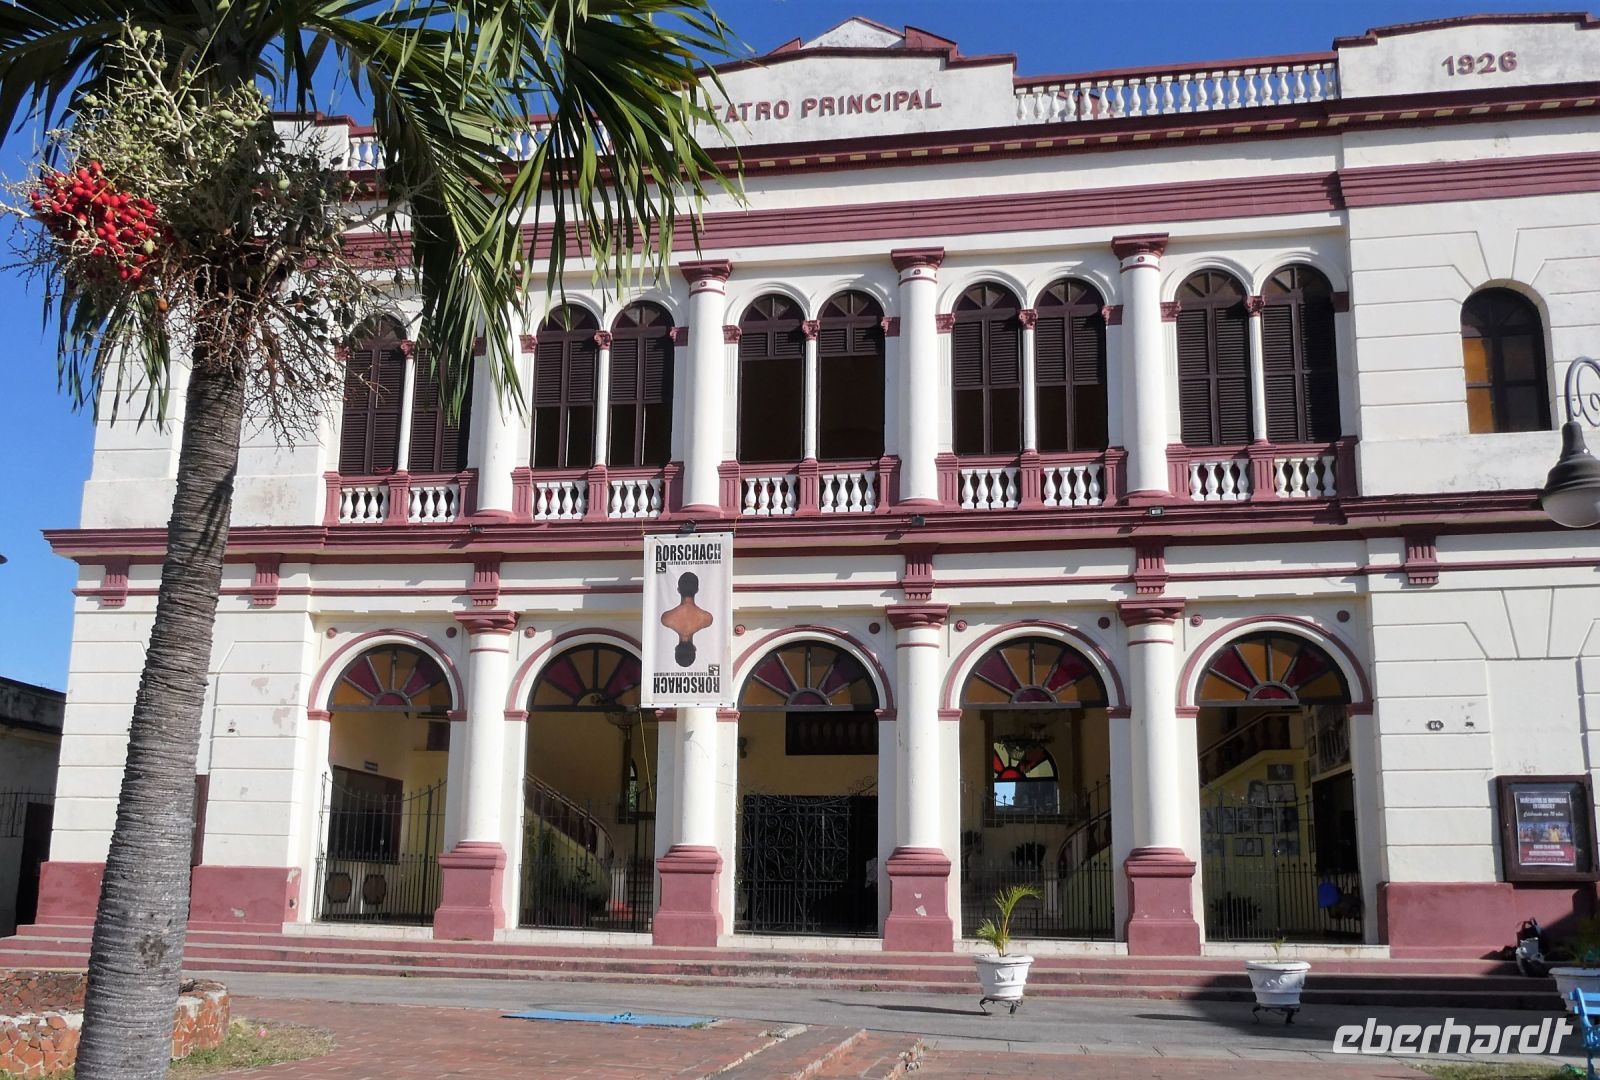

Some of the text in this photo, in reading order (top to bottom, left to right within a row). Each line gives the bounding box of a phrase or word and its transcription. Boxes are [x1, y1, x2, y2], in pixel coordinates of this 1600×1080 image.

[1441, 51, 1518, 76] 1926
[801, 88, 942, 119] PRINCIPAL
[656, 543, 721, 561] RORSCHACH
[653, 677, 720, 694] RORSCHACH
